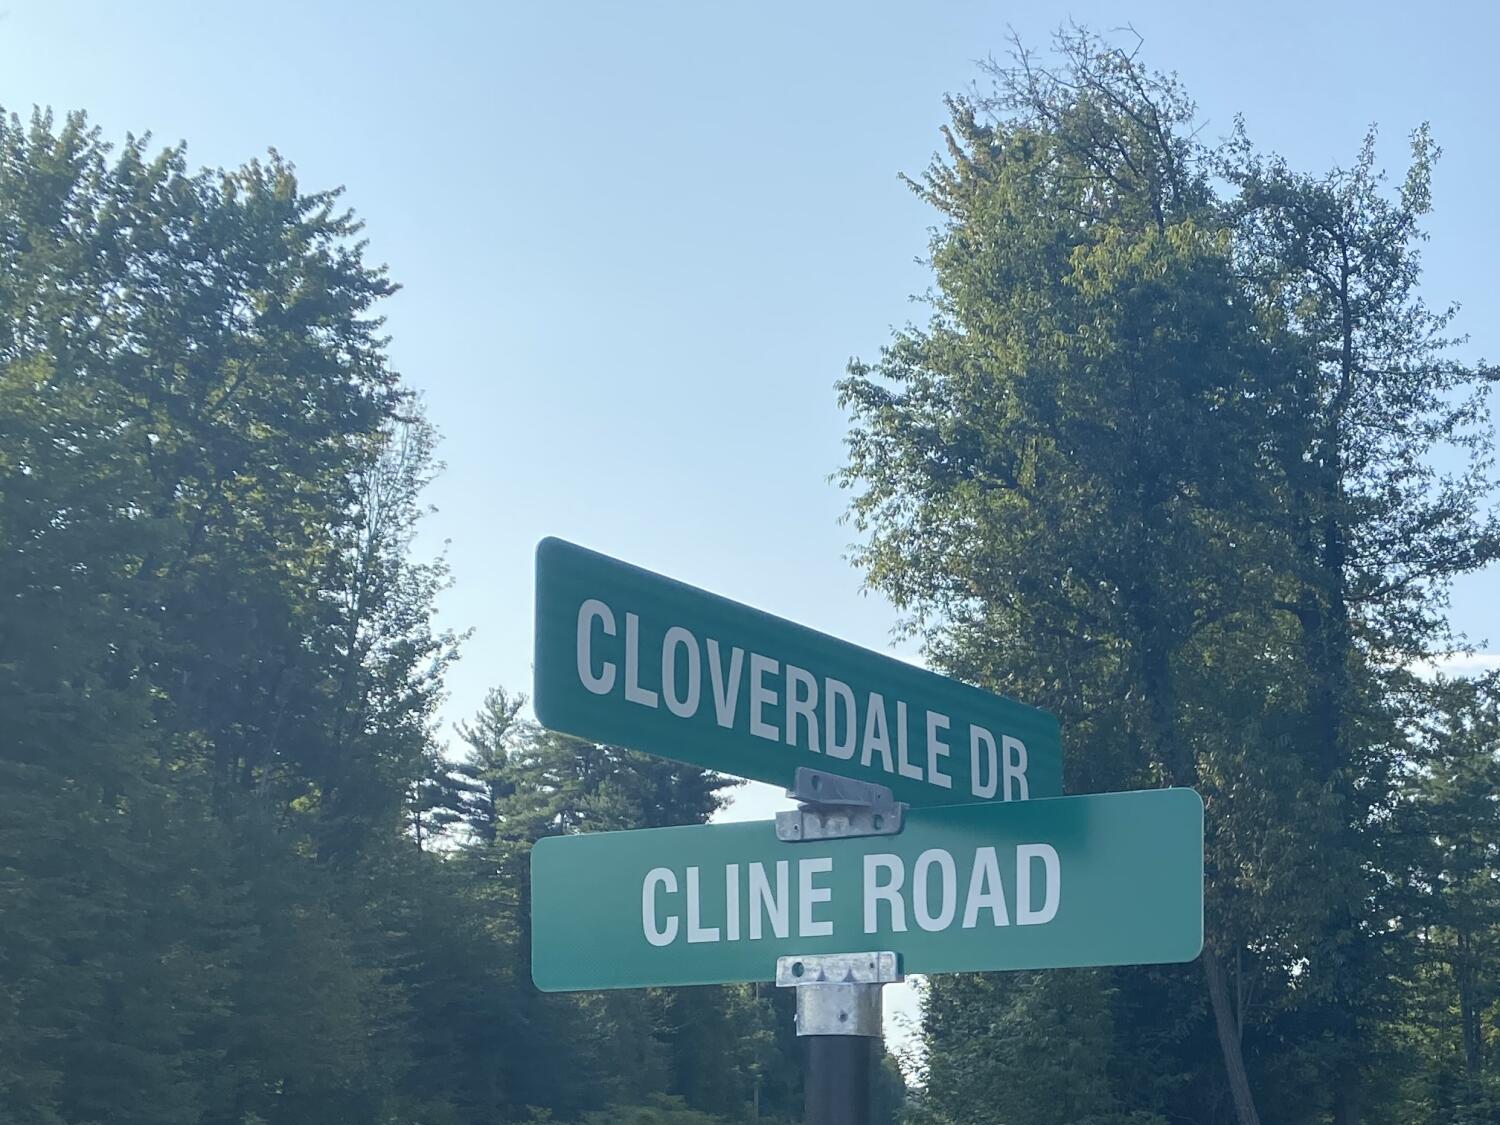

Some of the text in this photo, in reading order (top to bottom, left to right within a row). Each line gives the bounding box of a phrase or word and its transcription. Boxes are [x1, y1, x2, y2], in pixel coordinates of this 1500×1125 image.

[577, 599, 1029, 802] CLOVERDALE DR
[642, 843, 1061, 947] CLINE ROAD
